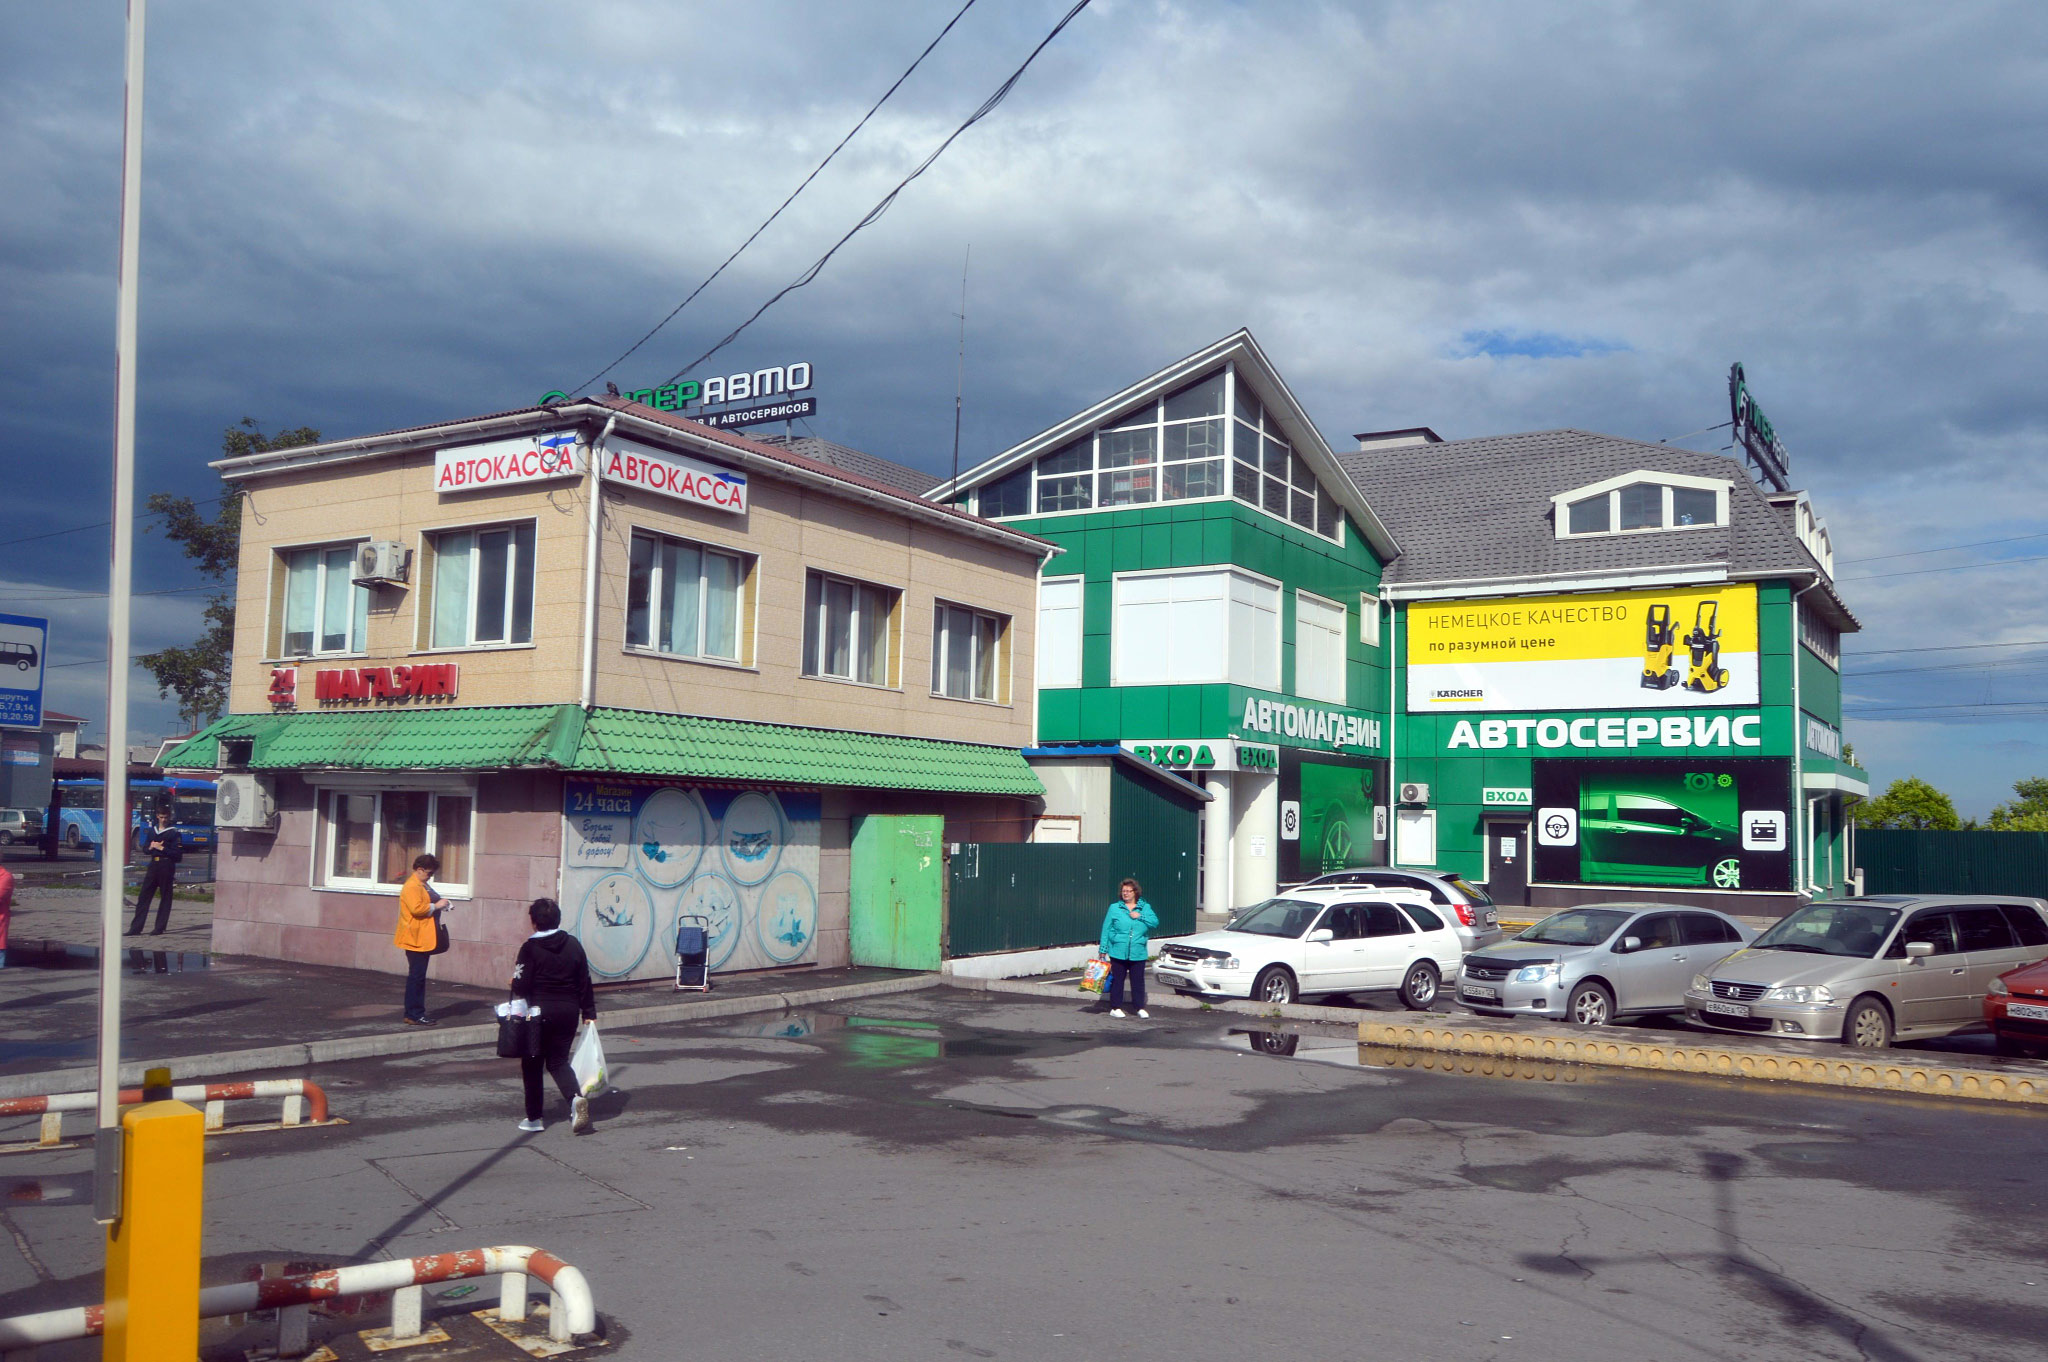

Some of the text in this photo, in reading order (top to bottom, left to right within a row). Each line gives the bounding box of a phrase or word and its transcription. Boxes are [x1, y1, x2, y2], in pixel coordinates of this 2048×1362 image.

[721, 402, 809, 425] АВТОСЕРВИСОВ
[438, 446, 574, 488] АВТОКАССА
[607, 452, 743, 510] АВТОКАССА
[1428, 605, 1628, 630] НЕМЕЦКОЕ КАЧЕСТВО
[1429, 637, 1556, 653] по разумной цене
[314, 663, 460, 700] МАГАЗИН
[1242, 696, 1381, 749] АВТОМАГАЗИН
[1447, 715, 1762, 749] АВТОСЕРВИС
[1133, 745, 1215, 767] ВХОД
[1240, 747, 1278, 769] ВХОД
[596, 784, 632, 797] Магазин
[1485, 791, 1529, 802] ВХОД
[573, 792, 632, 813] 24 часа
